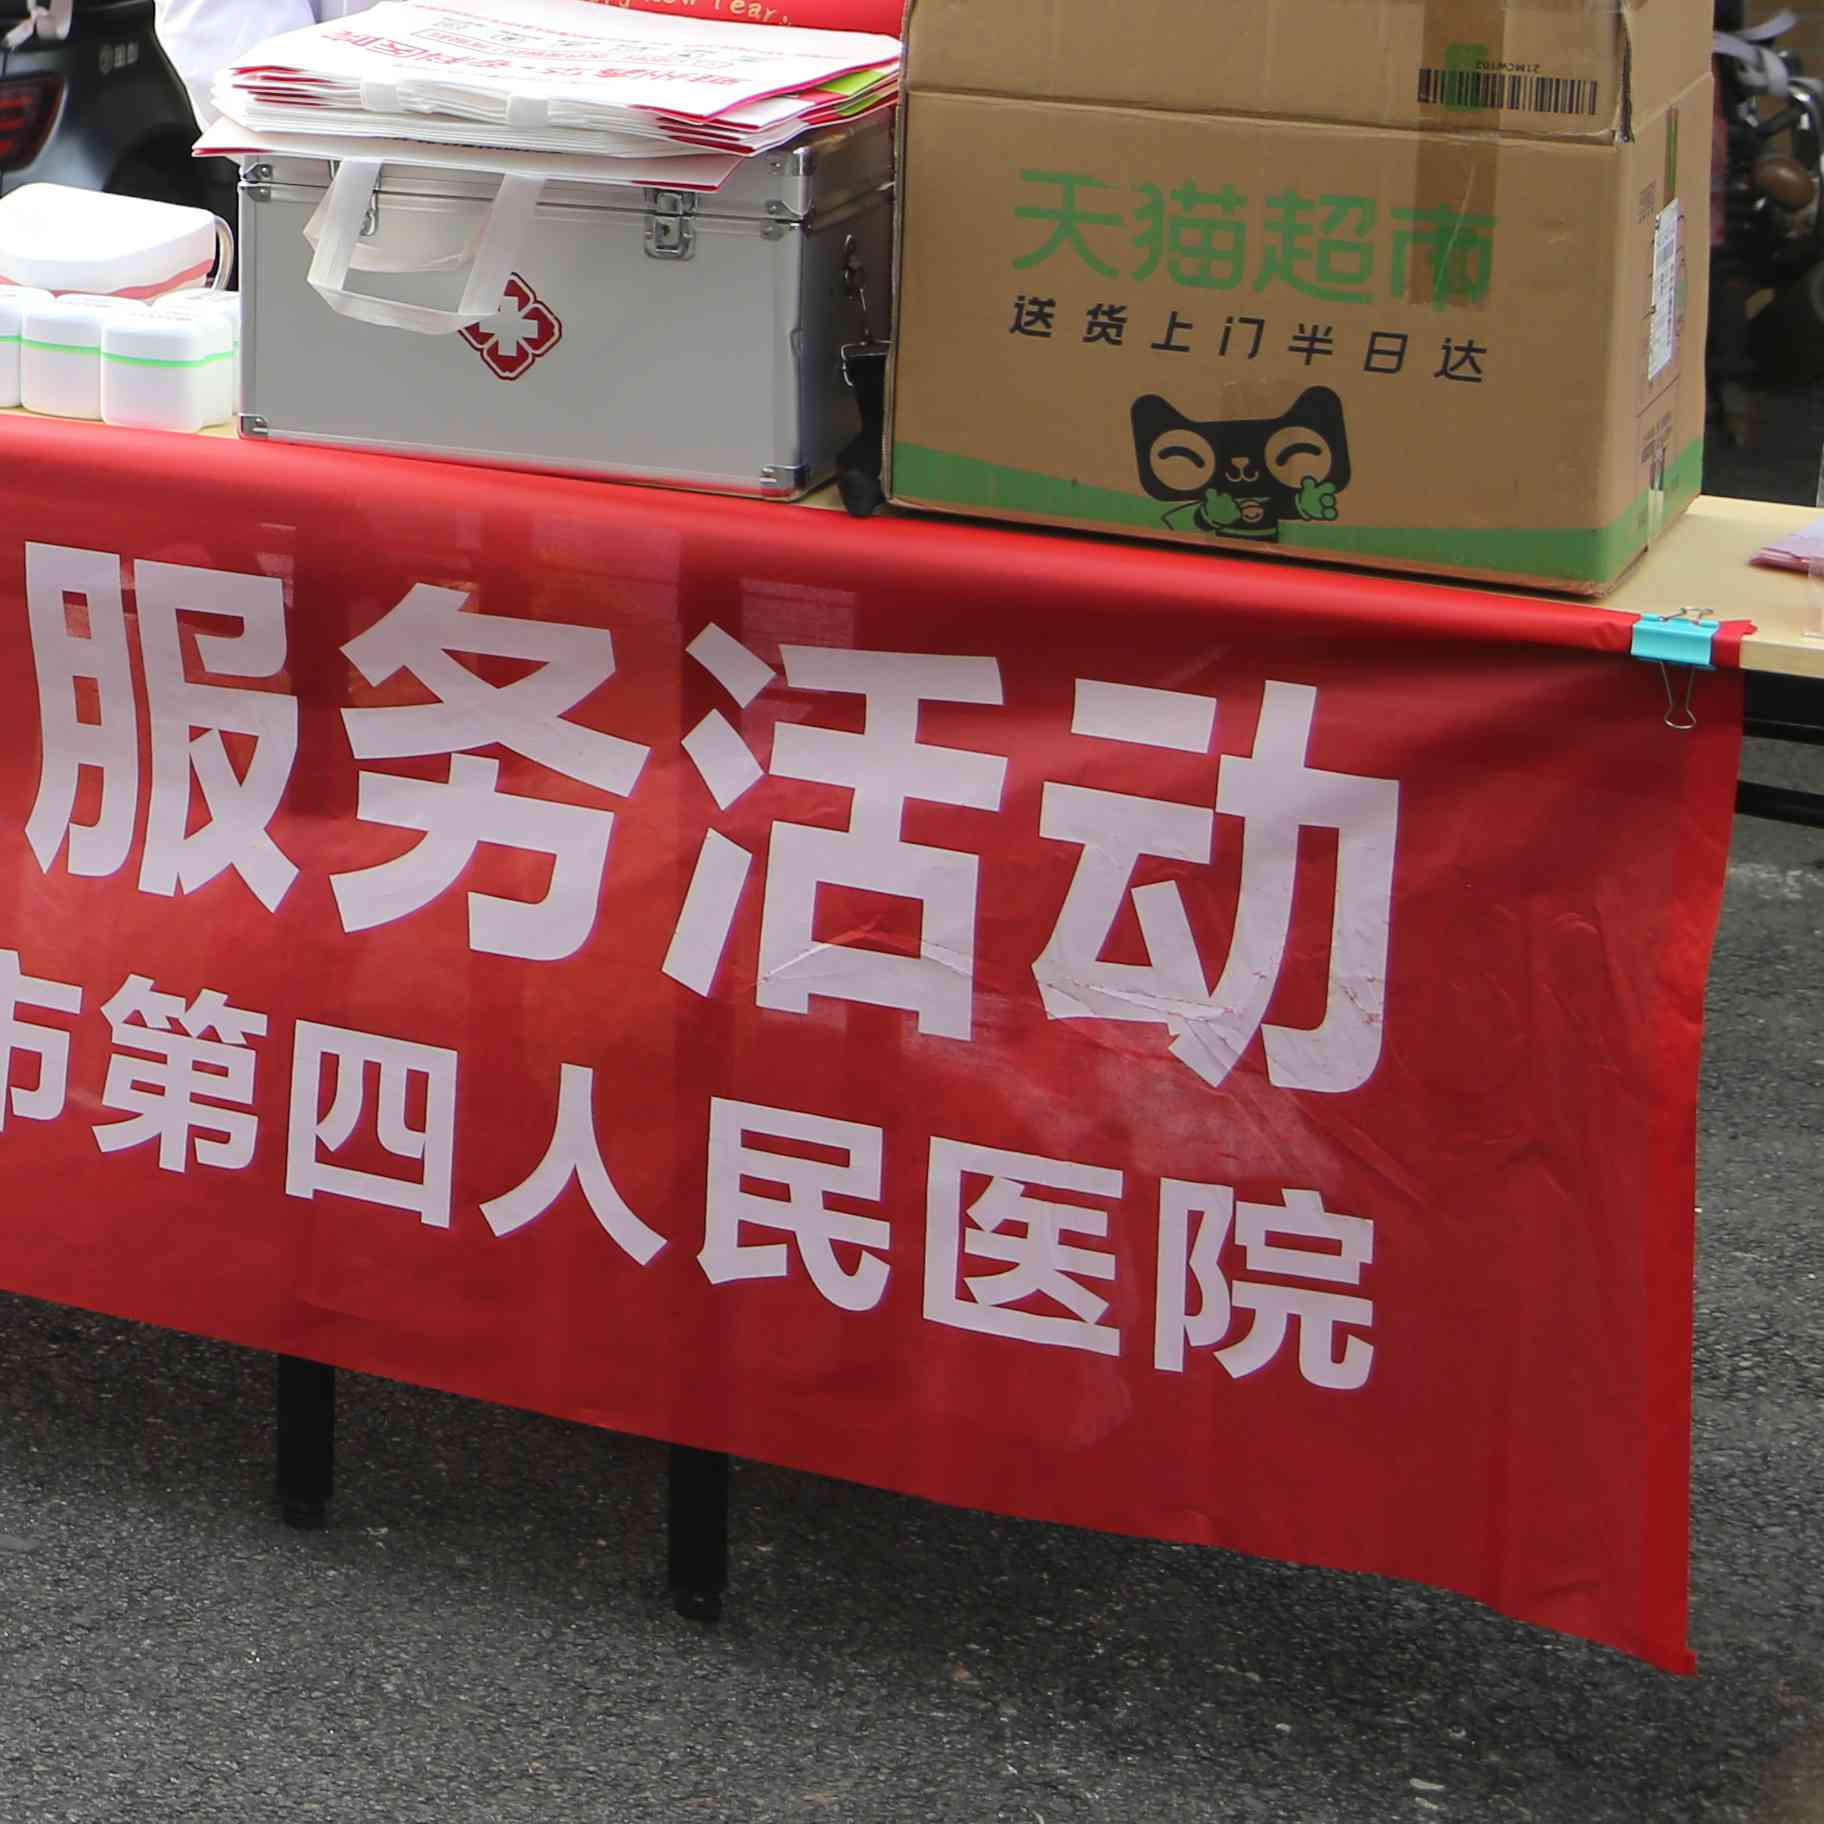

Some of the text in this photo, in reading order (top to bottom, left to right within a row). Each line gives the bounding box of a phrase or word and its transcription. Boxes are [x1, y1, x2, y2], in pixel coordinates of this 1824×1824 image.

[1011, 168, 1499, 313] 天猫超市
[1008, 293, 1489, 383] 送货上门半日达
